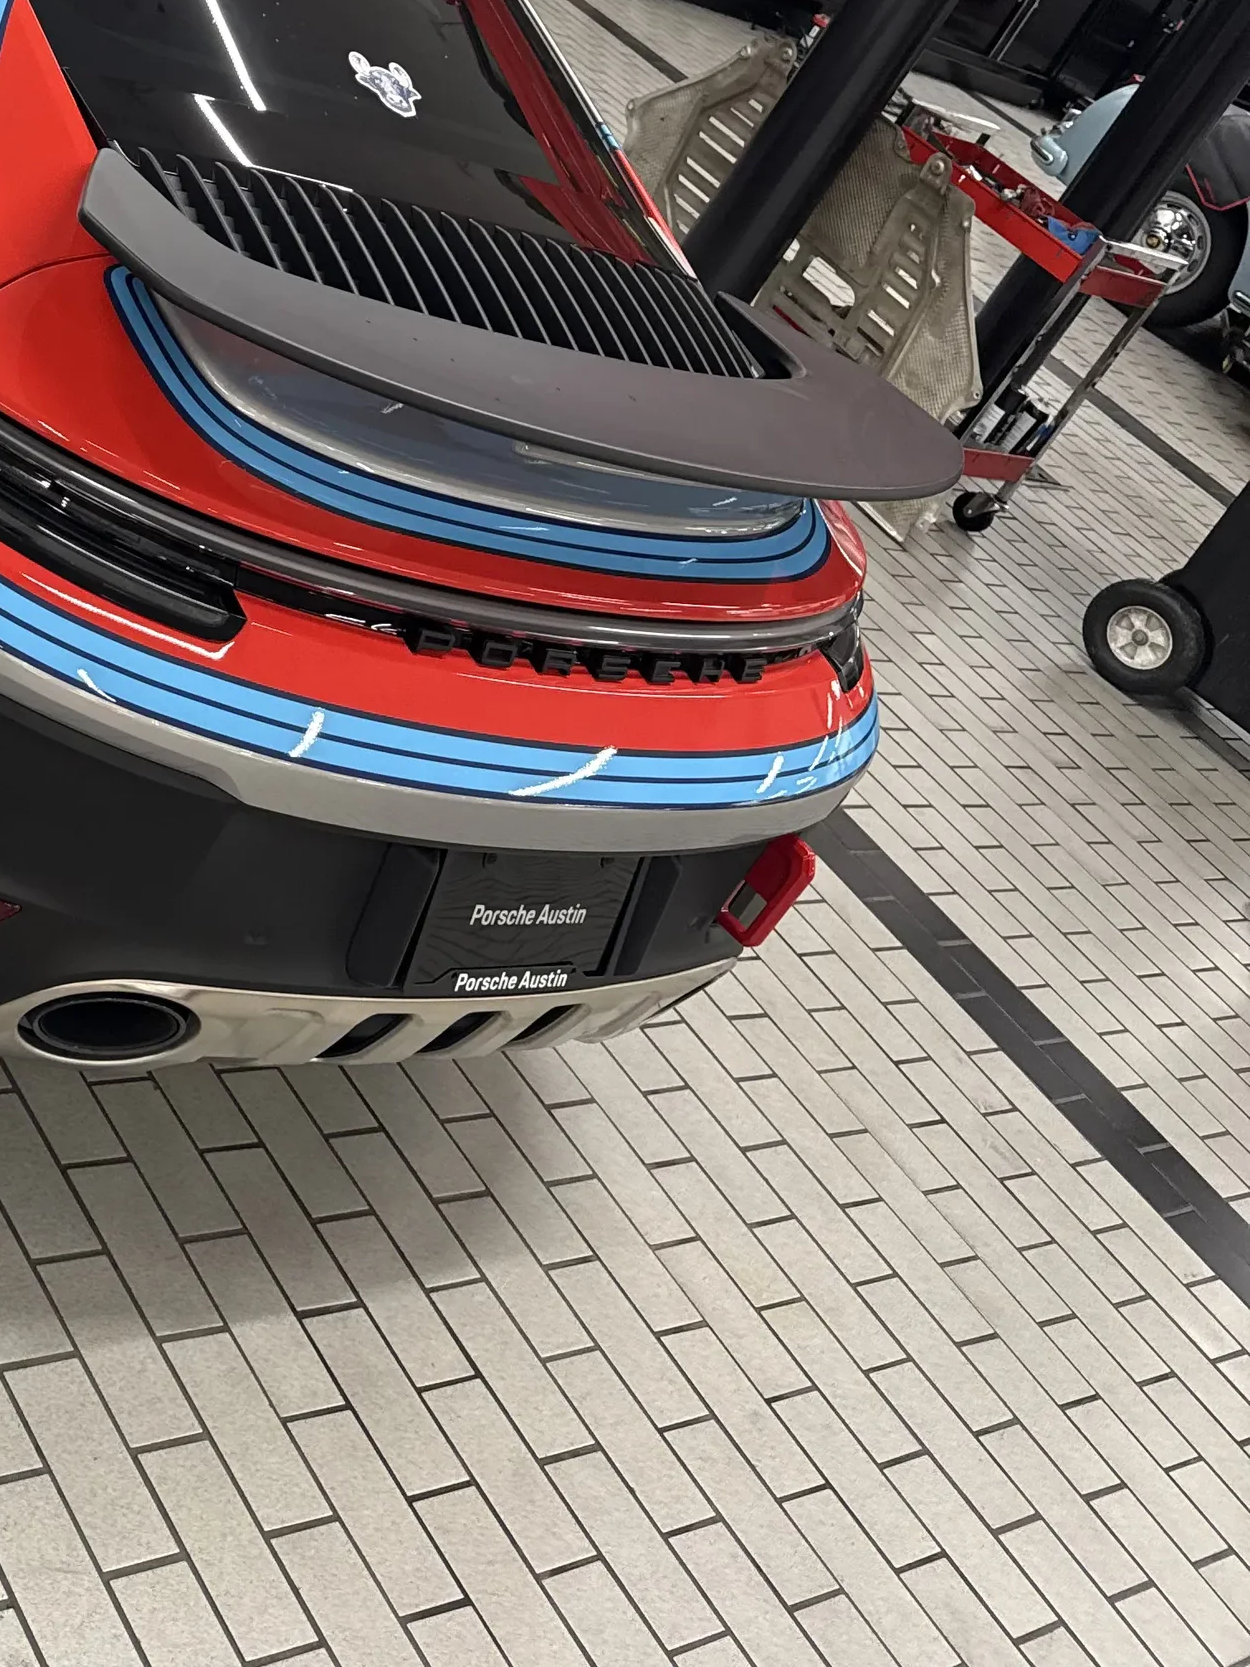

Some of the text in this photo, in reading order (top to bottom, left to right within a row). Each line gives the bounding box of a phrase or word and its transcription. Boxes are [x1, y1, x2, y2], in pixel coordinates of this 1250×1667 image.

[414, 628, 768, 685] PORSCHE
[469, 903, 587, 926] Porsche Austin
[454, 969, 568, 992] Porsche Austin
